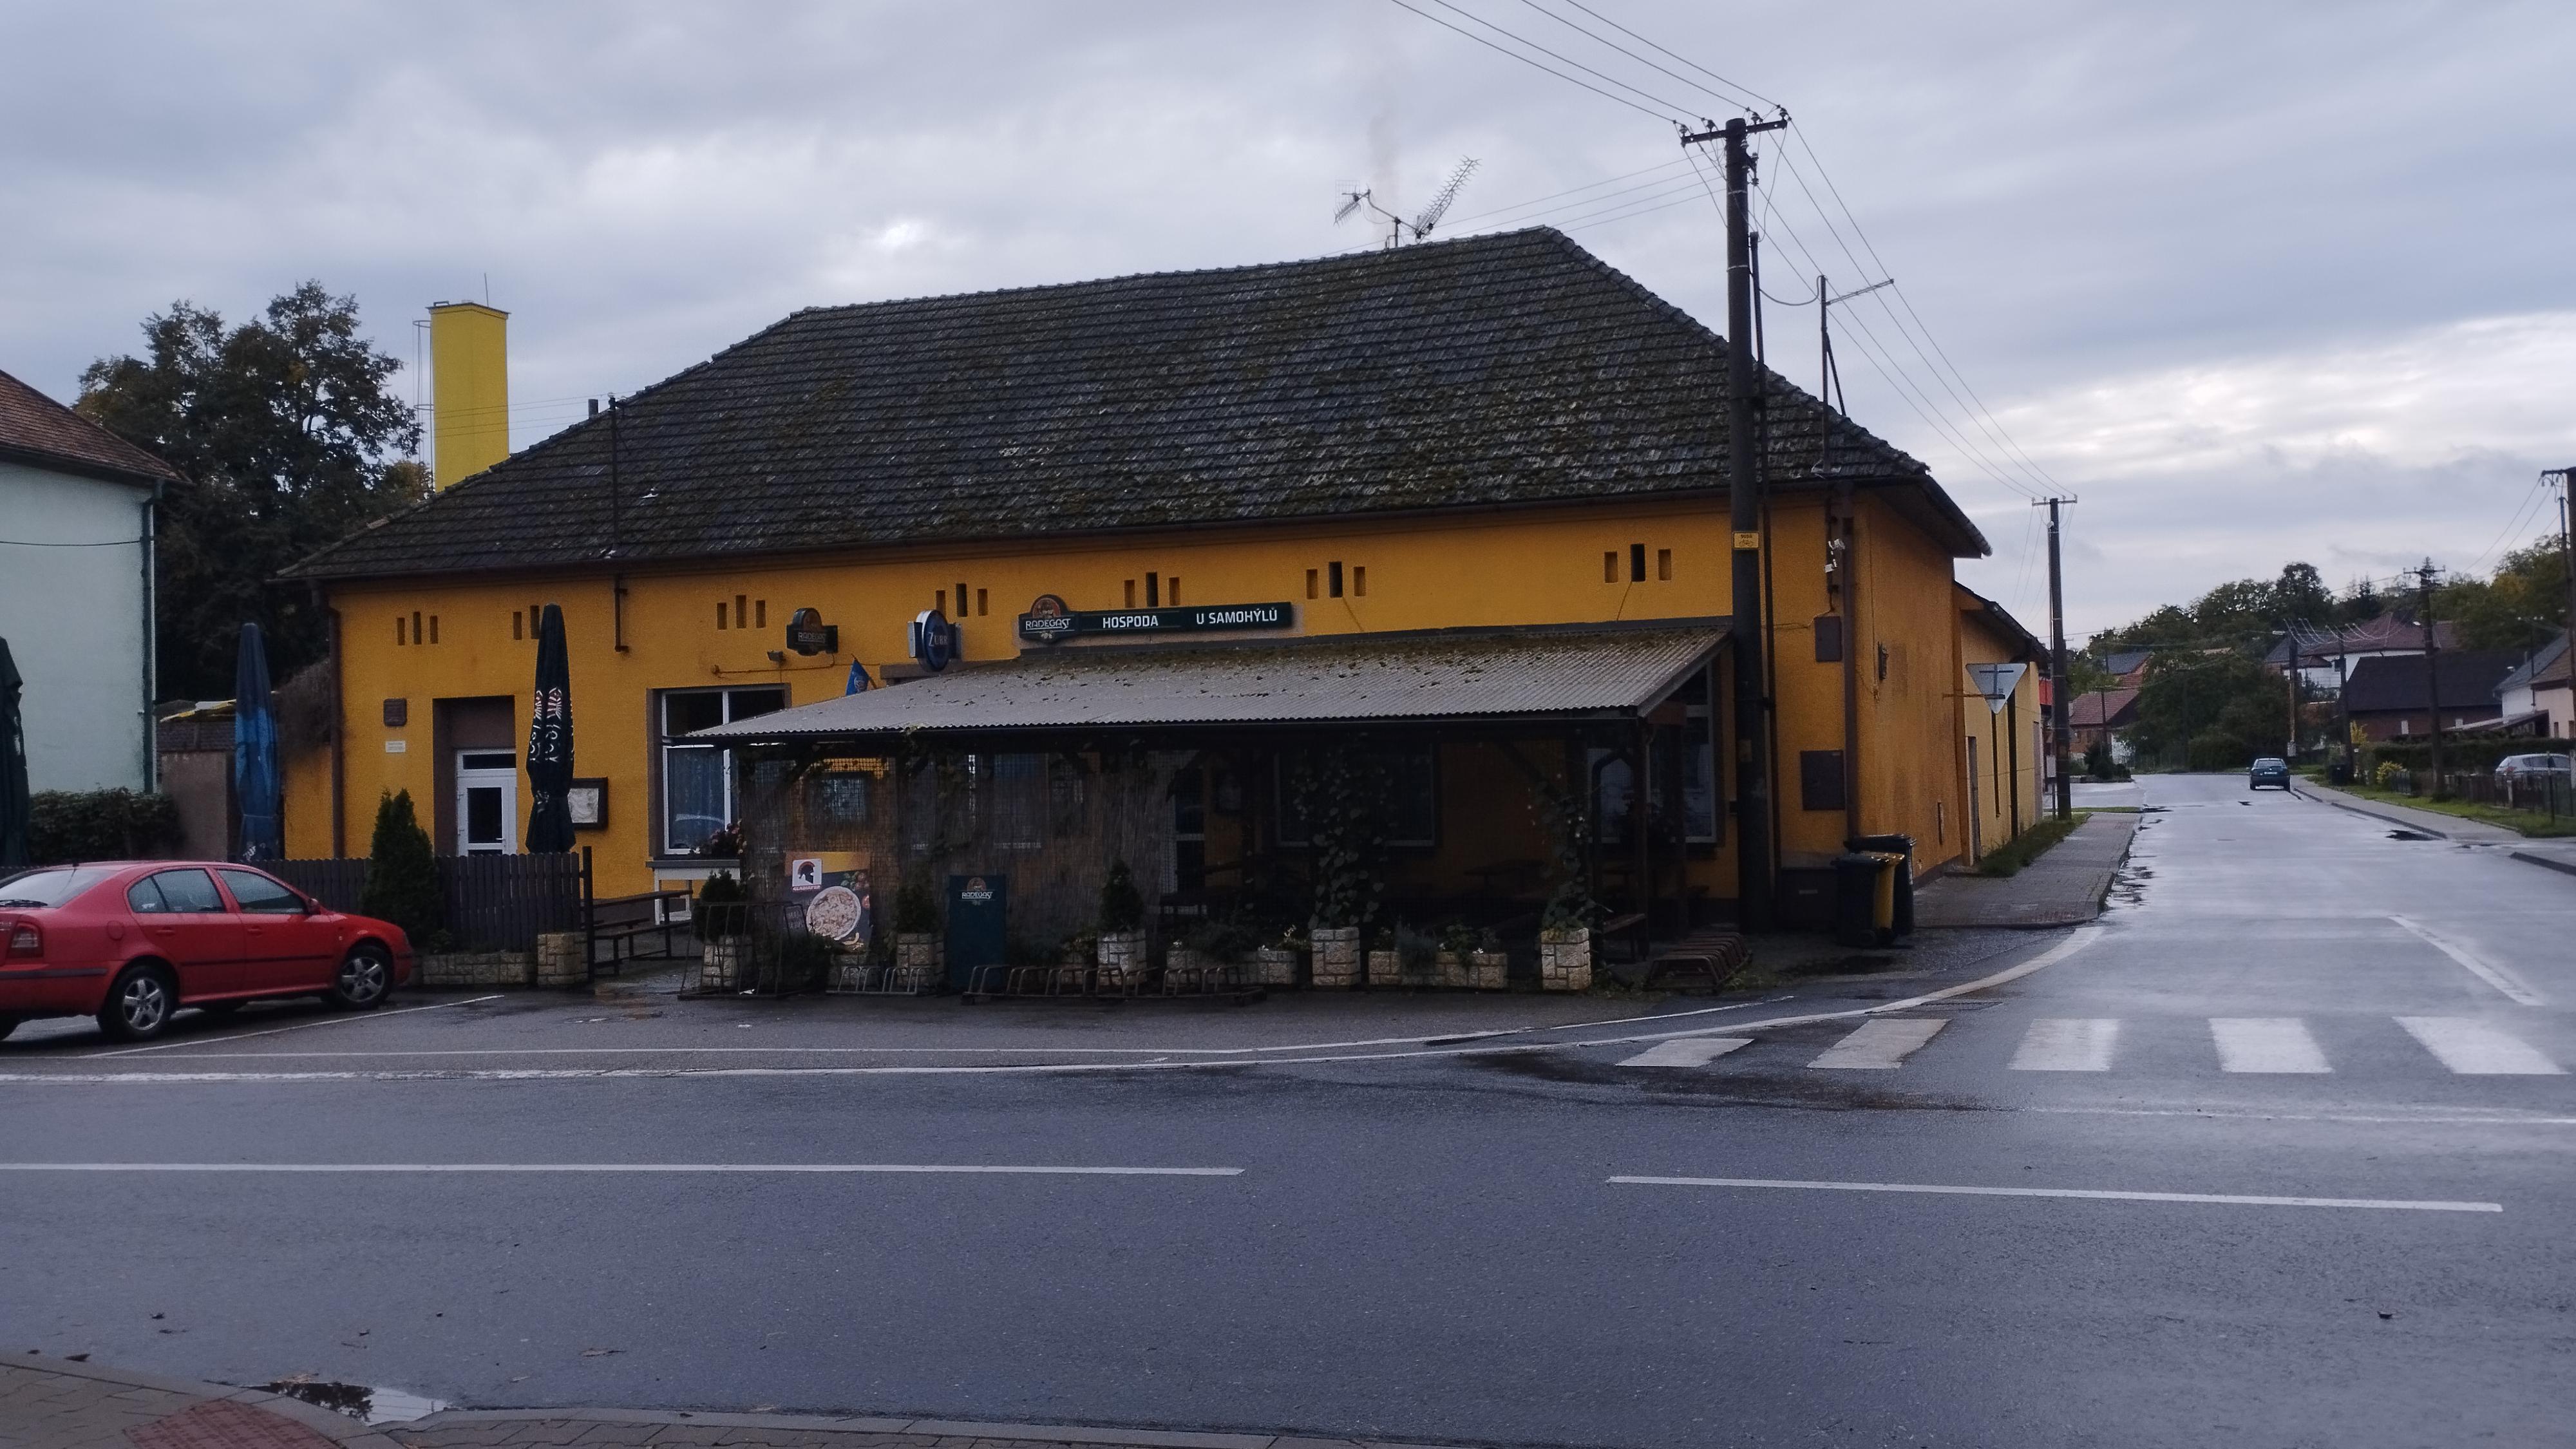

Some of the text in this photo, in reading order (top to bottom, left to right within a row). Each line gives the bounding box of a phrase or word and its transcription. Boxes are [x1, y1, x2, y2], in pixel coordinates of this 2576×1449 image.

[1025, 618, 1071, 630] RADEGAST
[1103, 607, 1278, 629] HOSPODA U SAMOHÝLŮ
